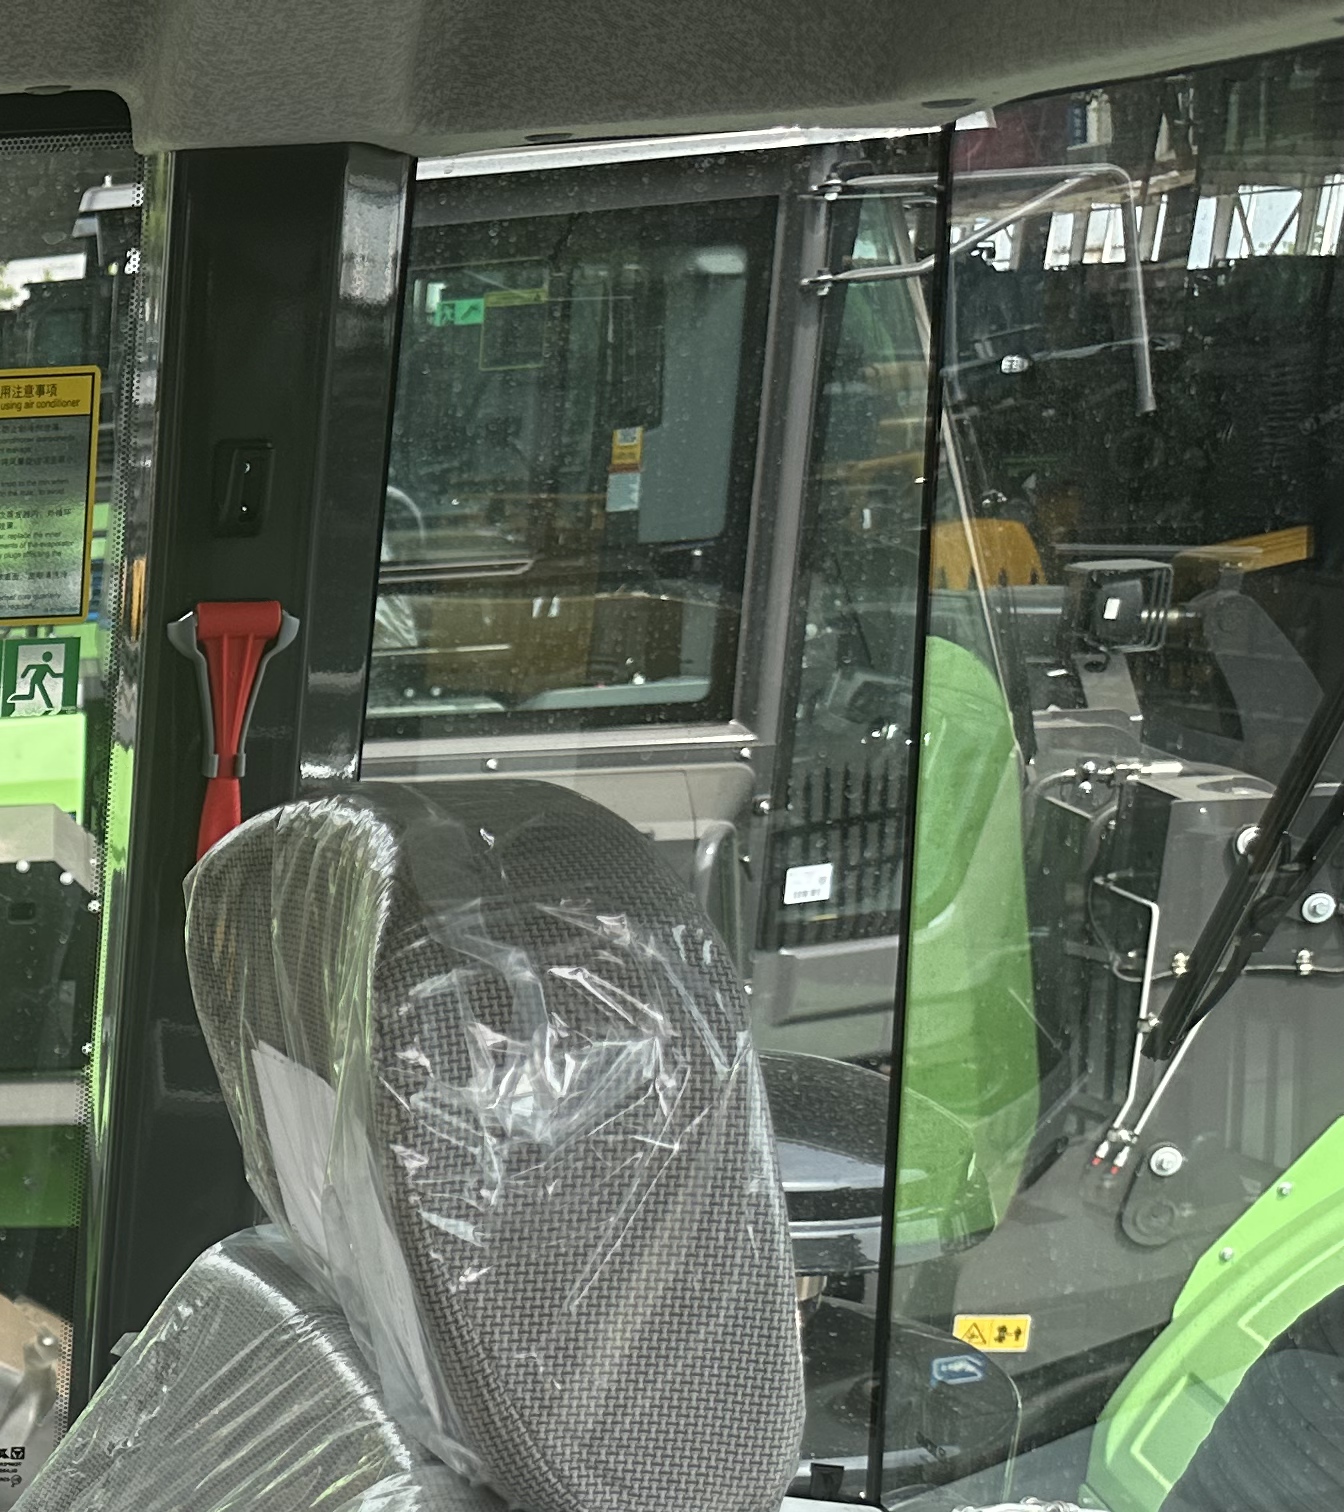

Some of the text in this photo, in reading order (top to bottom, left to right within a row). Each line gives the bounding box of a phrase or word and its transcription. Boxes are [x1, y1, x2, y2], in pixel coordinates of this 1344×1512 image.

[0, 399, 21, 411] using
[23, 399, 34, 410] air
[36, 397, 80, 409] conditioner
